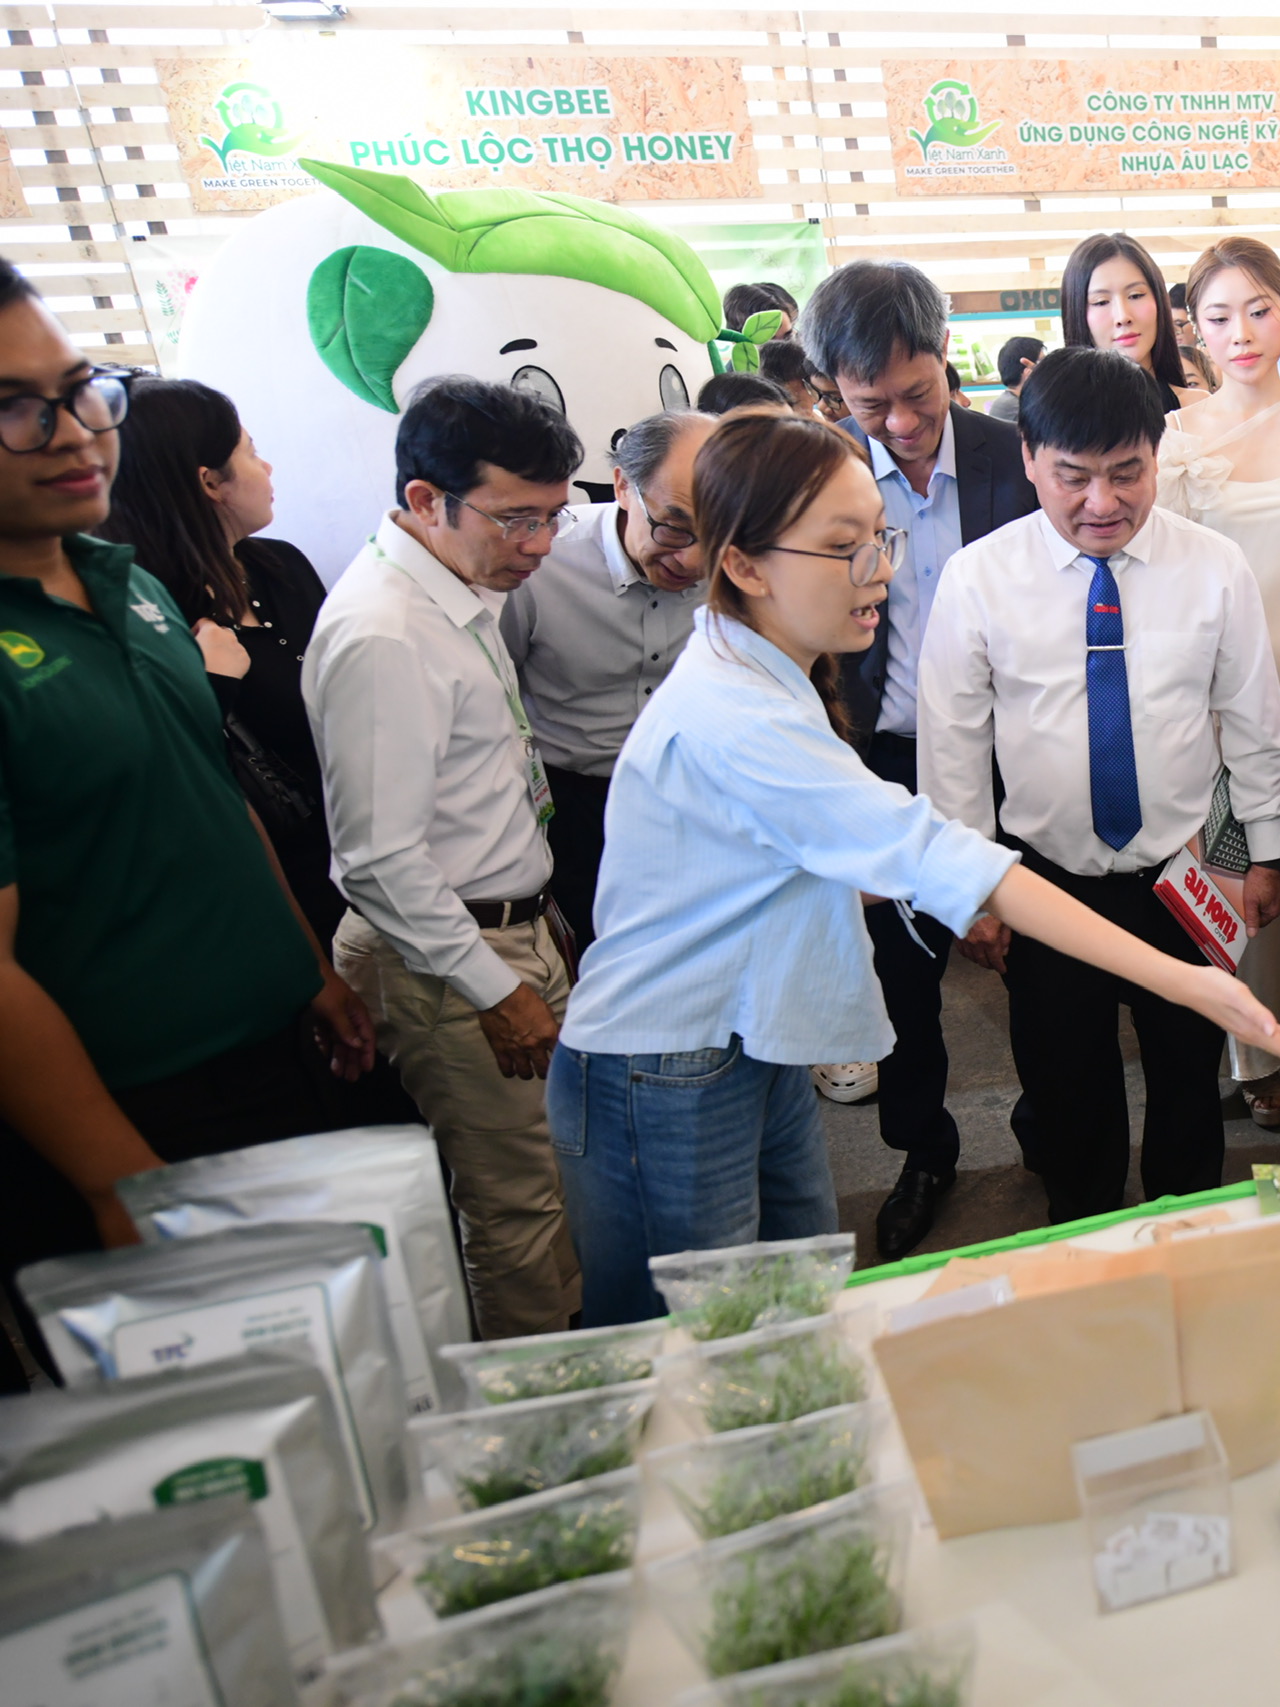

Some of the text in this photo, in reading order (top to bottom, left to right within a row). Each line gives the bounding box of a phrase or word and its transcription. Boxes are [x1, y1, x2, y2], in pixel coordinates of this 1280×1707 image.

[465, 88, 611, 116] KINGBEE
[1087, 90, 1273, 111] CÔNG TY TNHH MTV
[1019, 121, 1063, 143] ỨNG
[1069, 124, 1126, 147] DỤNG
[1132, 121, 1192, 142] CÔNG
[1198, 120, 1249, 145] NGHỆ
[1255, 119, 1278, 140] KỸ
[349, 131, 733, 172] PHÚC LỘC THỌ HONEY
[946, 149, 976, 160] Nam
[977, 148, 1006, 160] Xanh
[251, 159, 288, 171] Nam
[906, 165, 1015, 175] MAKE GREEN TOGETHER
[1121, 150, 1249, 176] NHỰA ÂU LẠC
[203, 179, 238, 188] MAKE
[239, 178, 278, 187] GREEN
